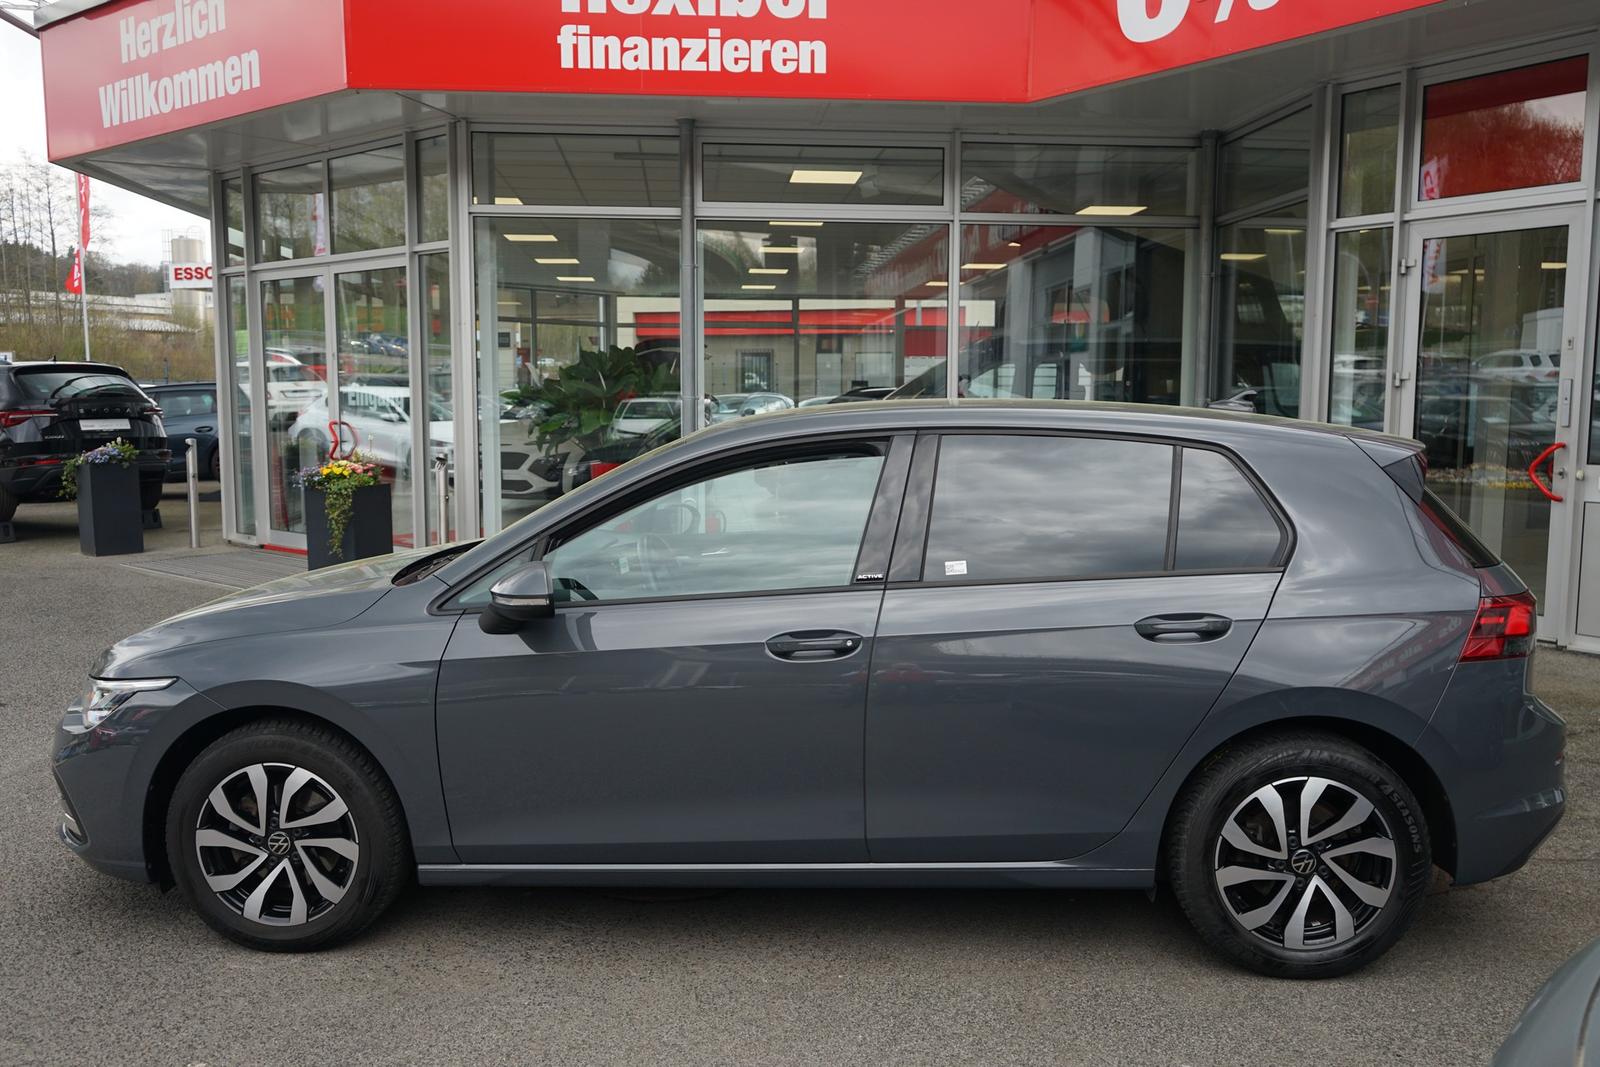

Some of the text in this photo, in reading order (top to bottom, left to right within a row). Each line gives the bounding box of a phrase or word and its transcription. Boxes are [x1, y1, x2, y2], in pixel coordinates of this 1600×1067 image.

[120, 0, 226, 64] Herzlich
[557, 24, 828, 74] finanzieren
[98, 49, 261, 129] Willkommen
